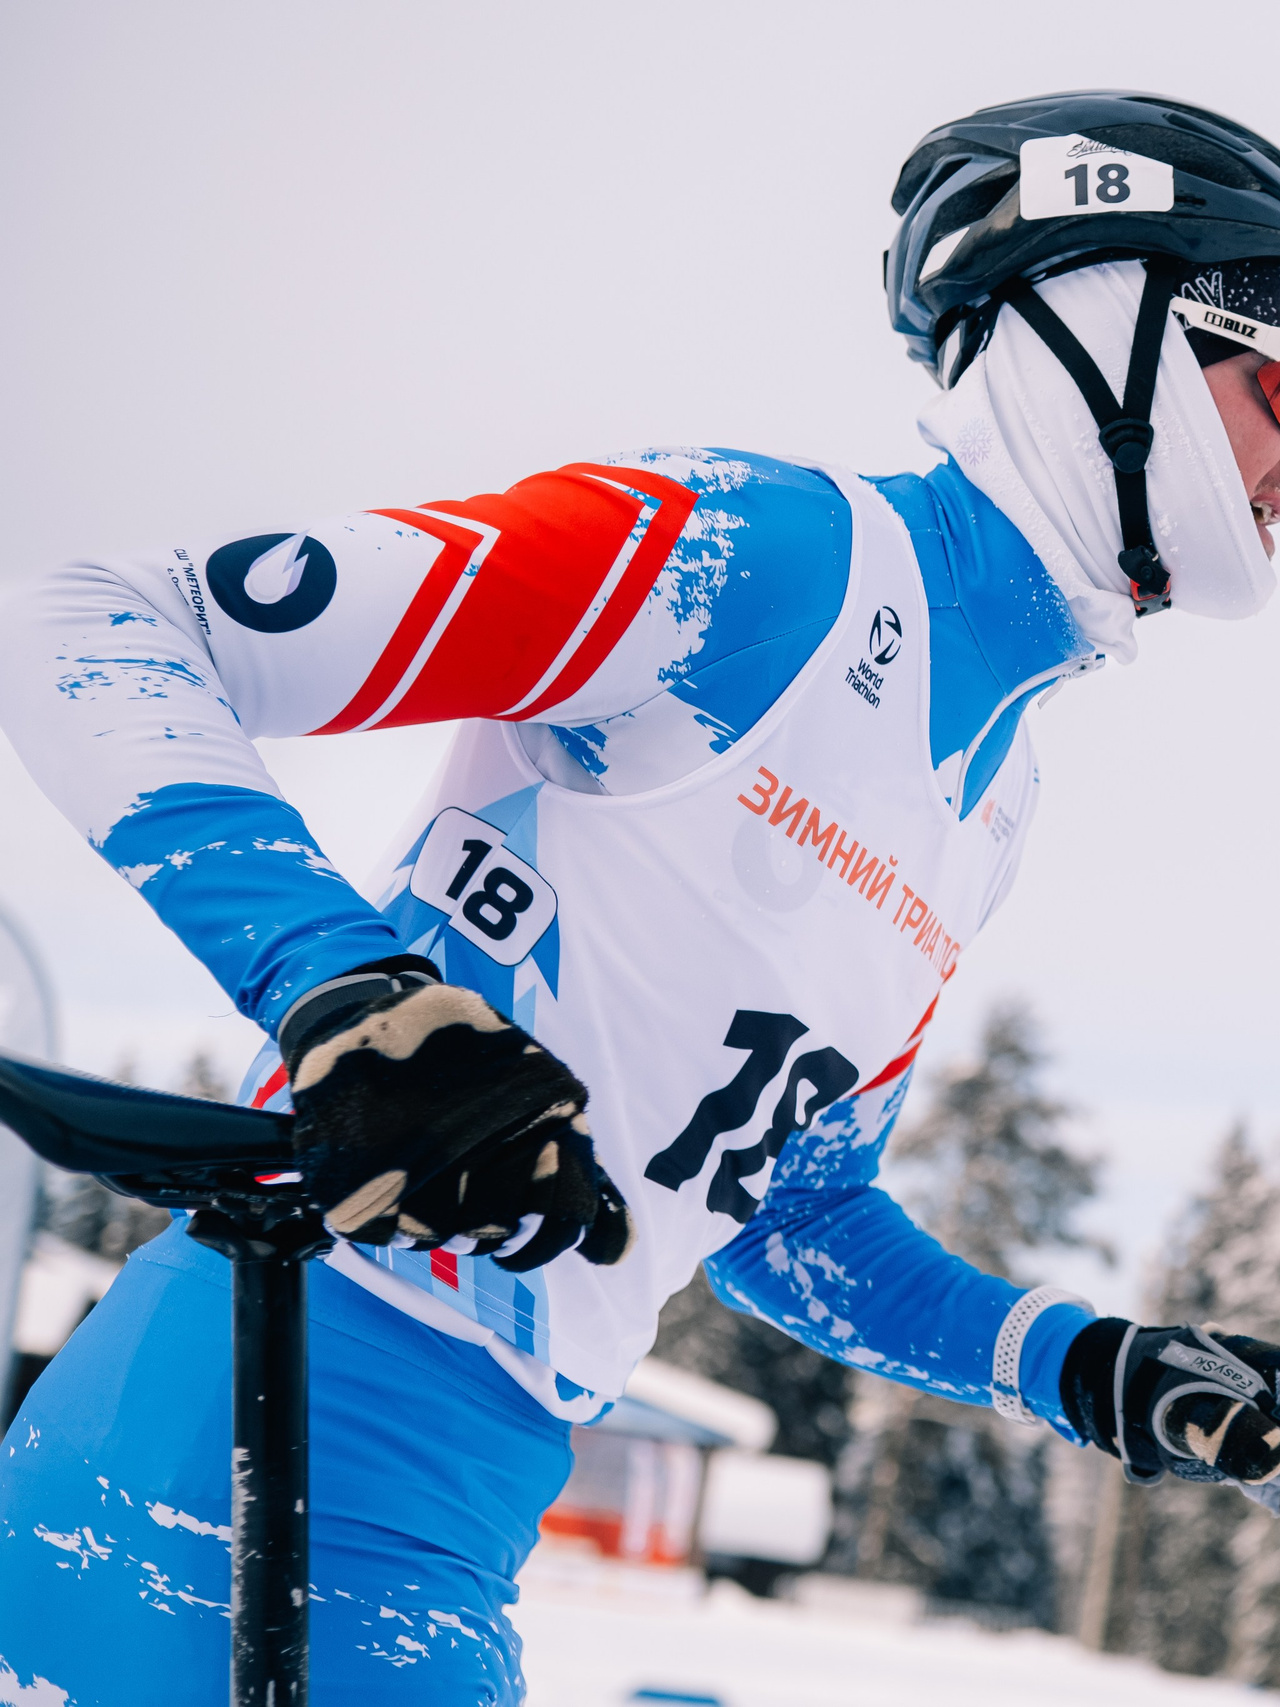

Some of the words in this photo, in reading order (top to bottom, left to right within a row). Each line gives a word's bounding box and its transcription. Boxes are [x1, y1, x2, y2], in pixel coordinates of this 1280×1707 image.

[1063, 162, 1131, 207] 18
[1223, 317, 1258, 340] BLIZ
[844, 666, 881, 709] Triathlon
[857, 658, 884, 690] World
[736, 765, 899, 911] ЗИМНИЙ
[445, 839, 534, 941] 18
[1189, 1356, 1254, 1390] EasySki
